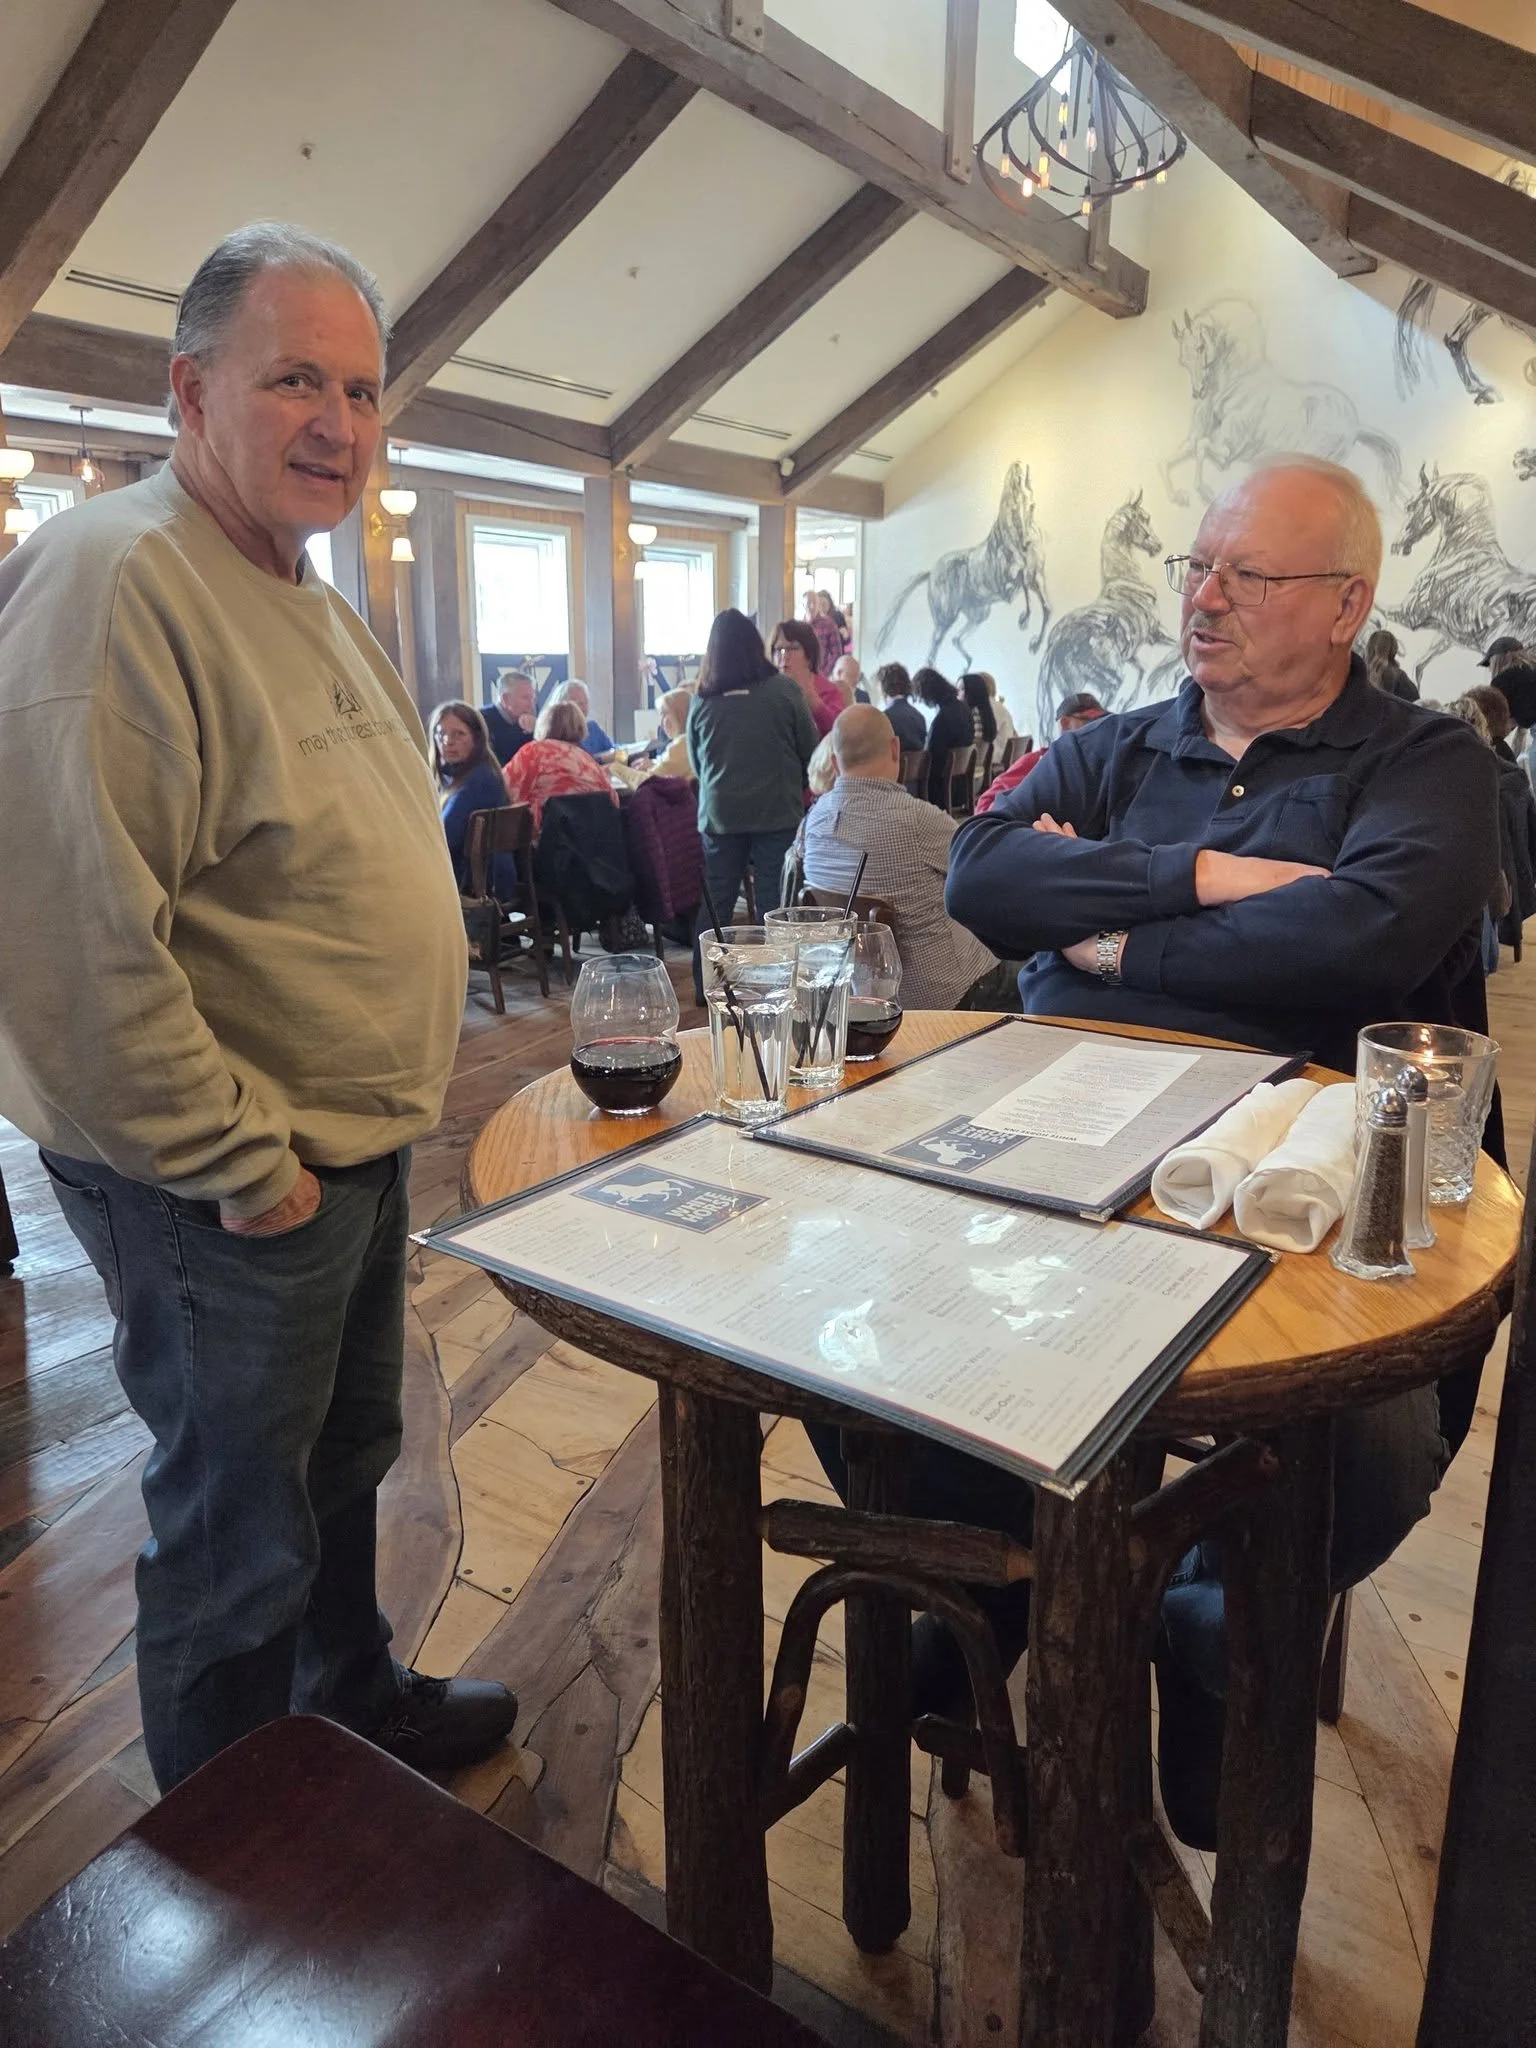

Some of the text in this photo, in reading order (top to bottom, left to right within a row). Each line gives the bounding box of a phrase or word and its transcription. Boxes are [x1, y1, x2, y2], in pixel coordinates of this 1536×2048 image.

[298, 732, 329, 756] may
[947, 1126, 1006, 1144] WHITE
[1049, 1133, 1077, 1142] WHITE
[665, 1191, 722, 1217] WHITE
[681, 1195, 740, 1223] HORSE
